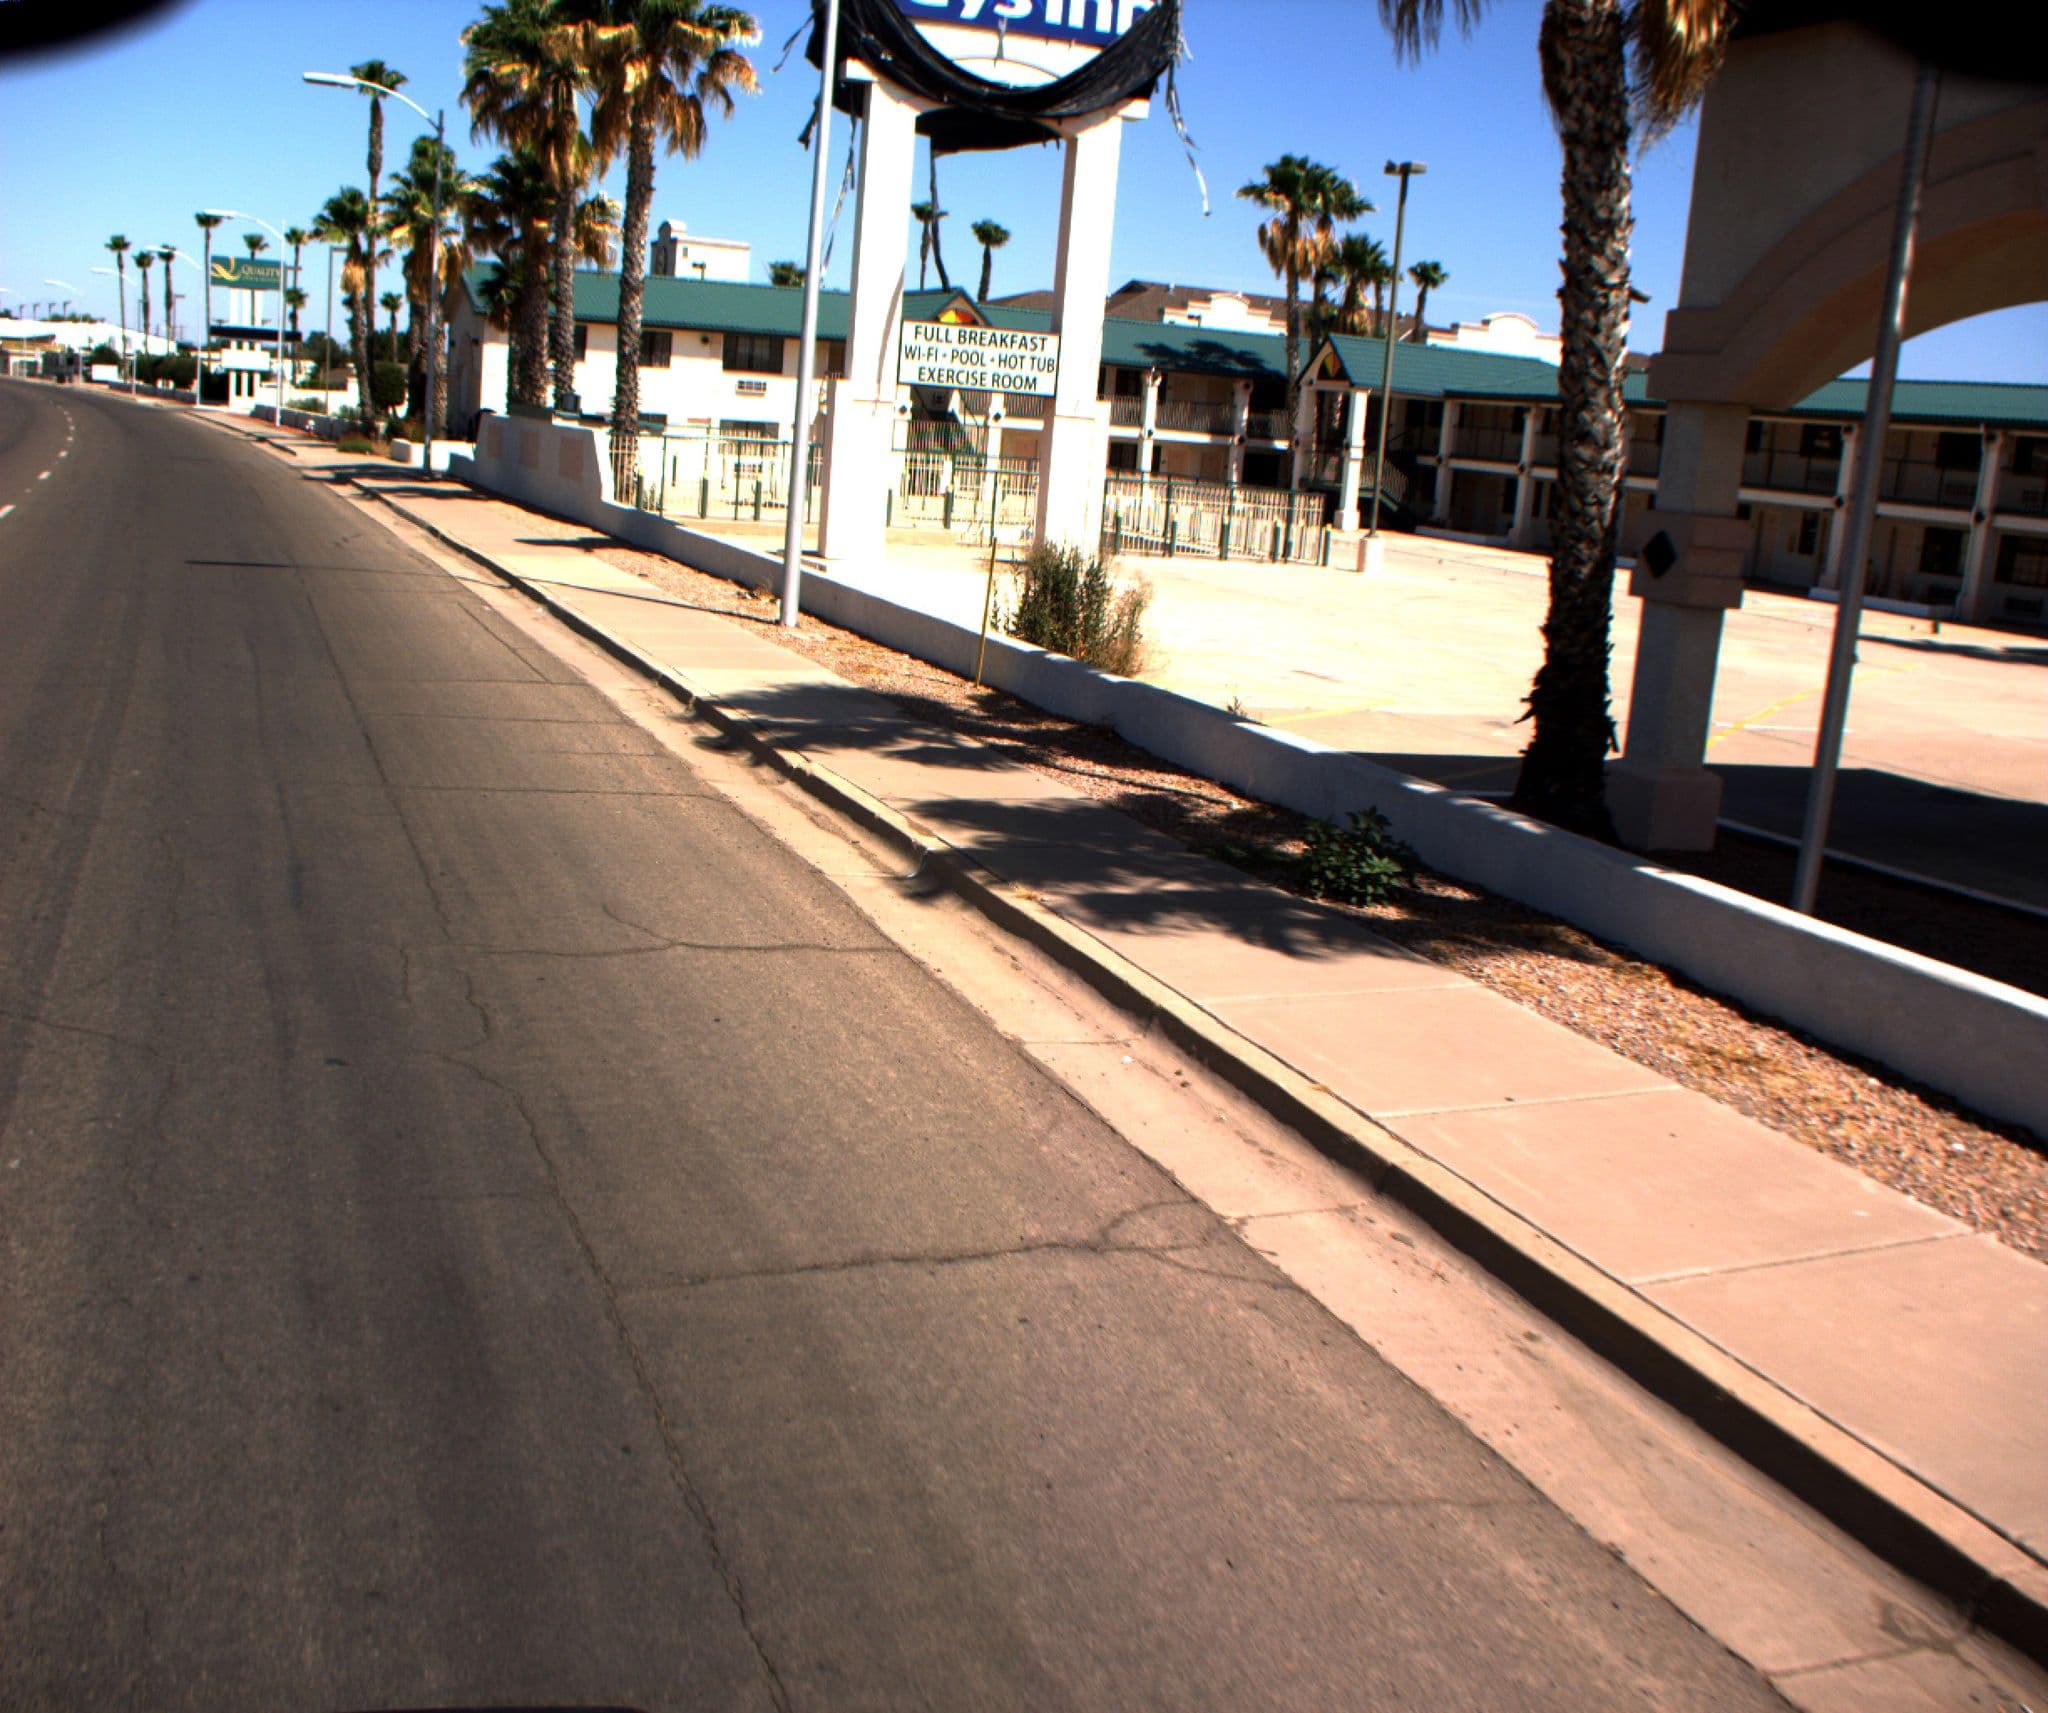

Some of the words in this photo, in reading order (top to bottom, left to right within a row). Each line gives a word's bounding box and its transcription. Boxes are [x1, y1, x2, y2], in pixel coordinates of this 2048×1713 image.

[914, 325, 953, 344] FULL
[958, 329, 1048, 351] BREAKFAST
[904, 345, 938, 362] WI-FI
[951, 349, 987, 367] POOL
[998, 353, 1024, 370] HOT
[1030, 356, 1055, 373] TUB
[918, 366, 988, 386] EXERCISE
[991, 372, 1037, 391] ROOM
